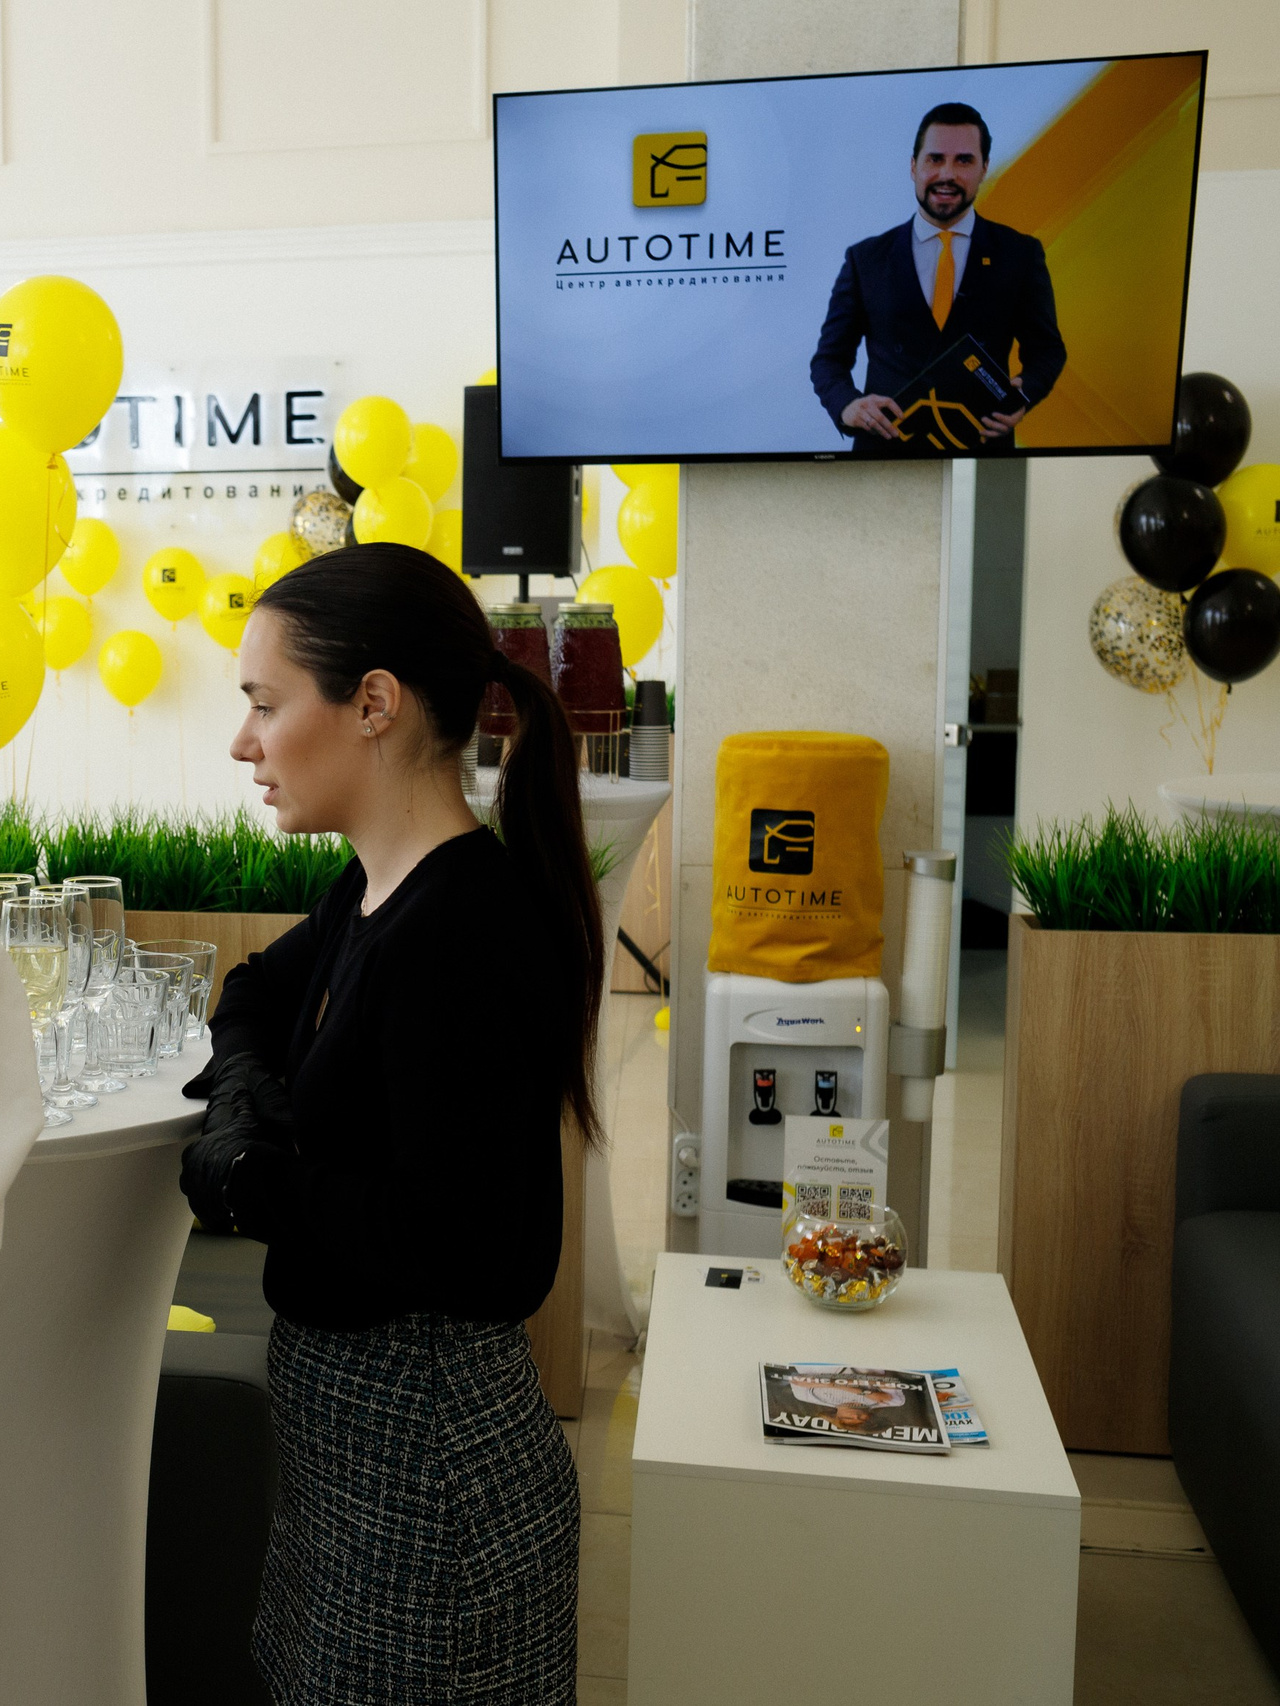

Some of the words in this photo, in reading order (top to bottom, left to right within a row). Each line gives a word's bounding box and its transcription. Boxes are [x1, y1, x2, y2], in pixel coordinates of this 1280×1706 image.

[556, 229, 786, 265] AUTOTIME
[556, 279, 606, 291] Центр
[615, 273, 786, 288] автокредитования
[727, 884, 843, 907] AUTOTIME
